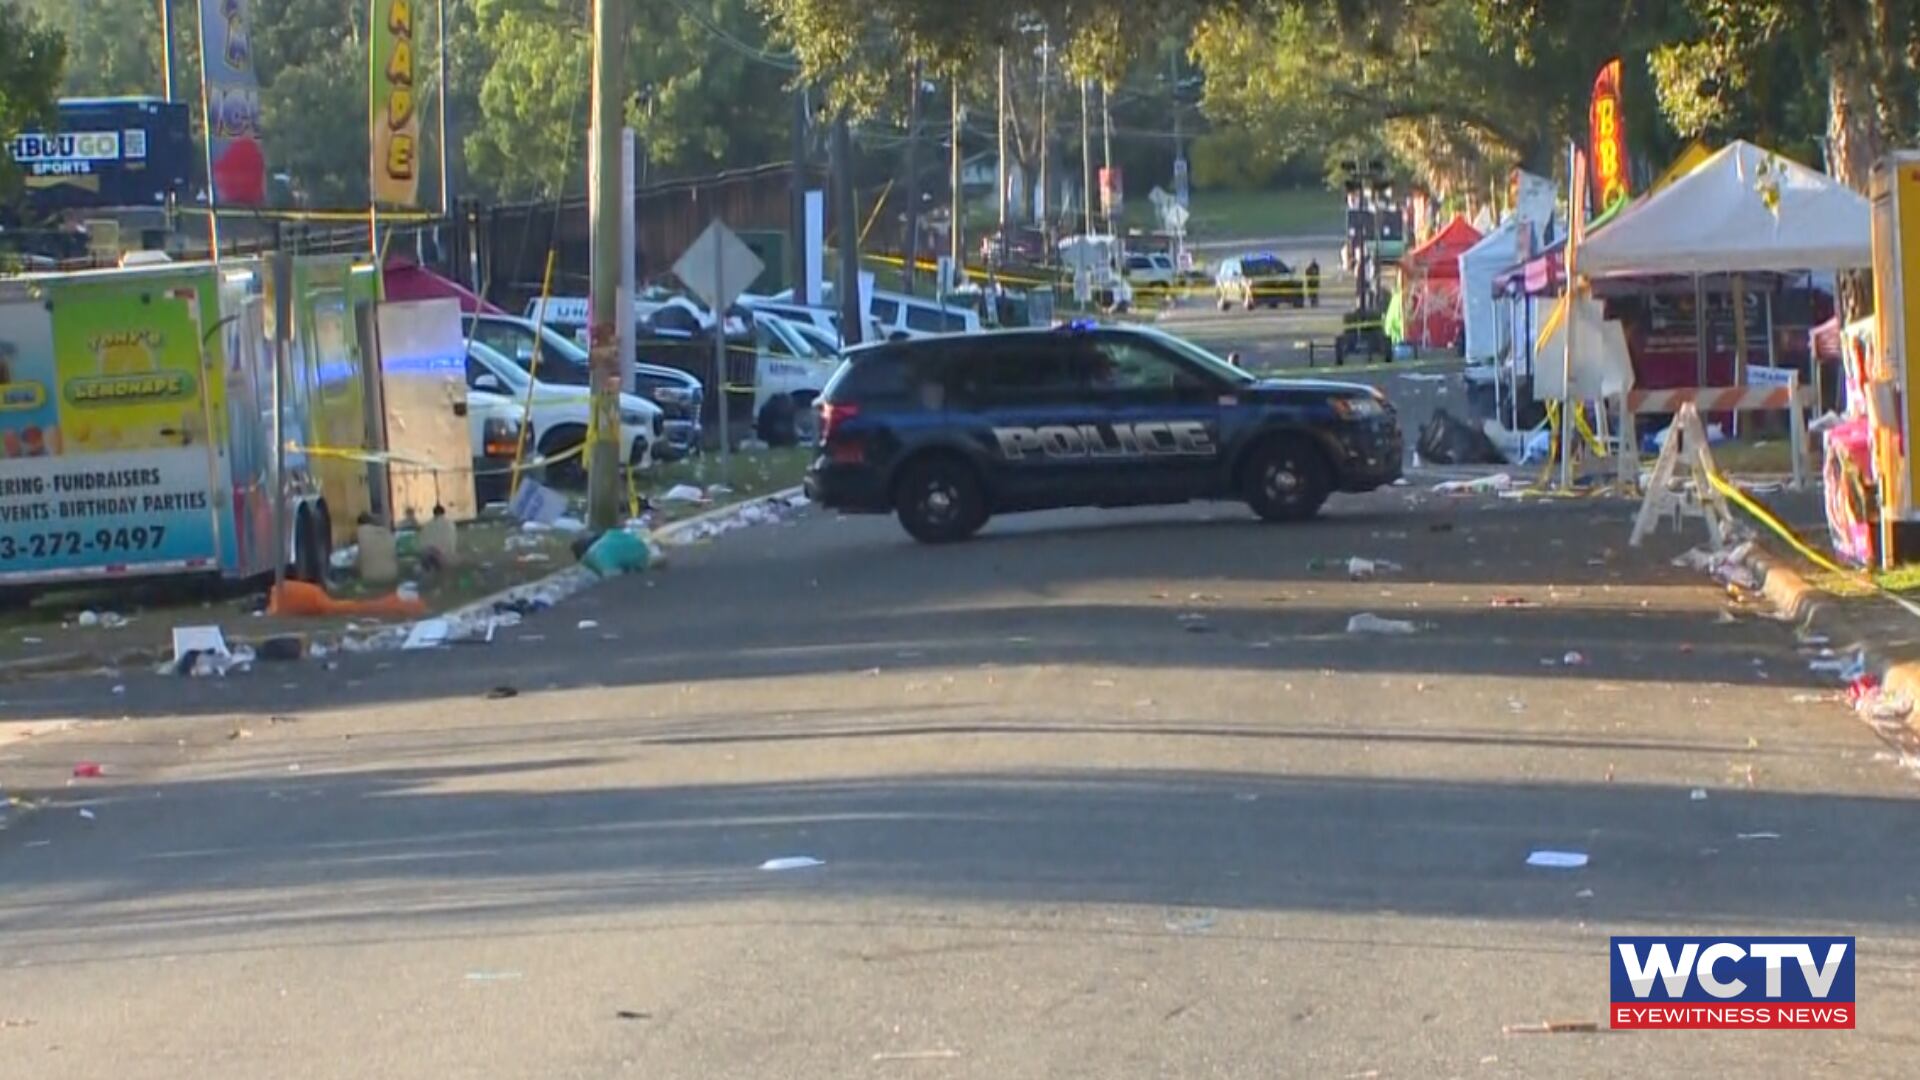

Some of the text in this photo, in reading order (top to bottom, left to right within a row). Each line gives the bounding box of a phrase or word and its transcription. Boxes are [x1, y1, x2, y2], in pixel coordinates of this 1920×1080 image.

[32, 161, 91, 174] SPORTS
[993, 421, 1216, 460] POLICE
[53, 468, 161, 492] FUNDRAISERS
[59, 496, 142, 518] BIRTHDAY
[143, 491, 207, 513] PARTIES
